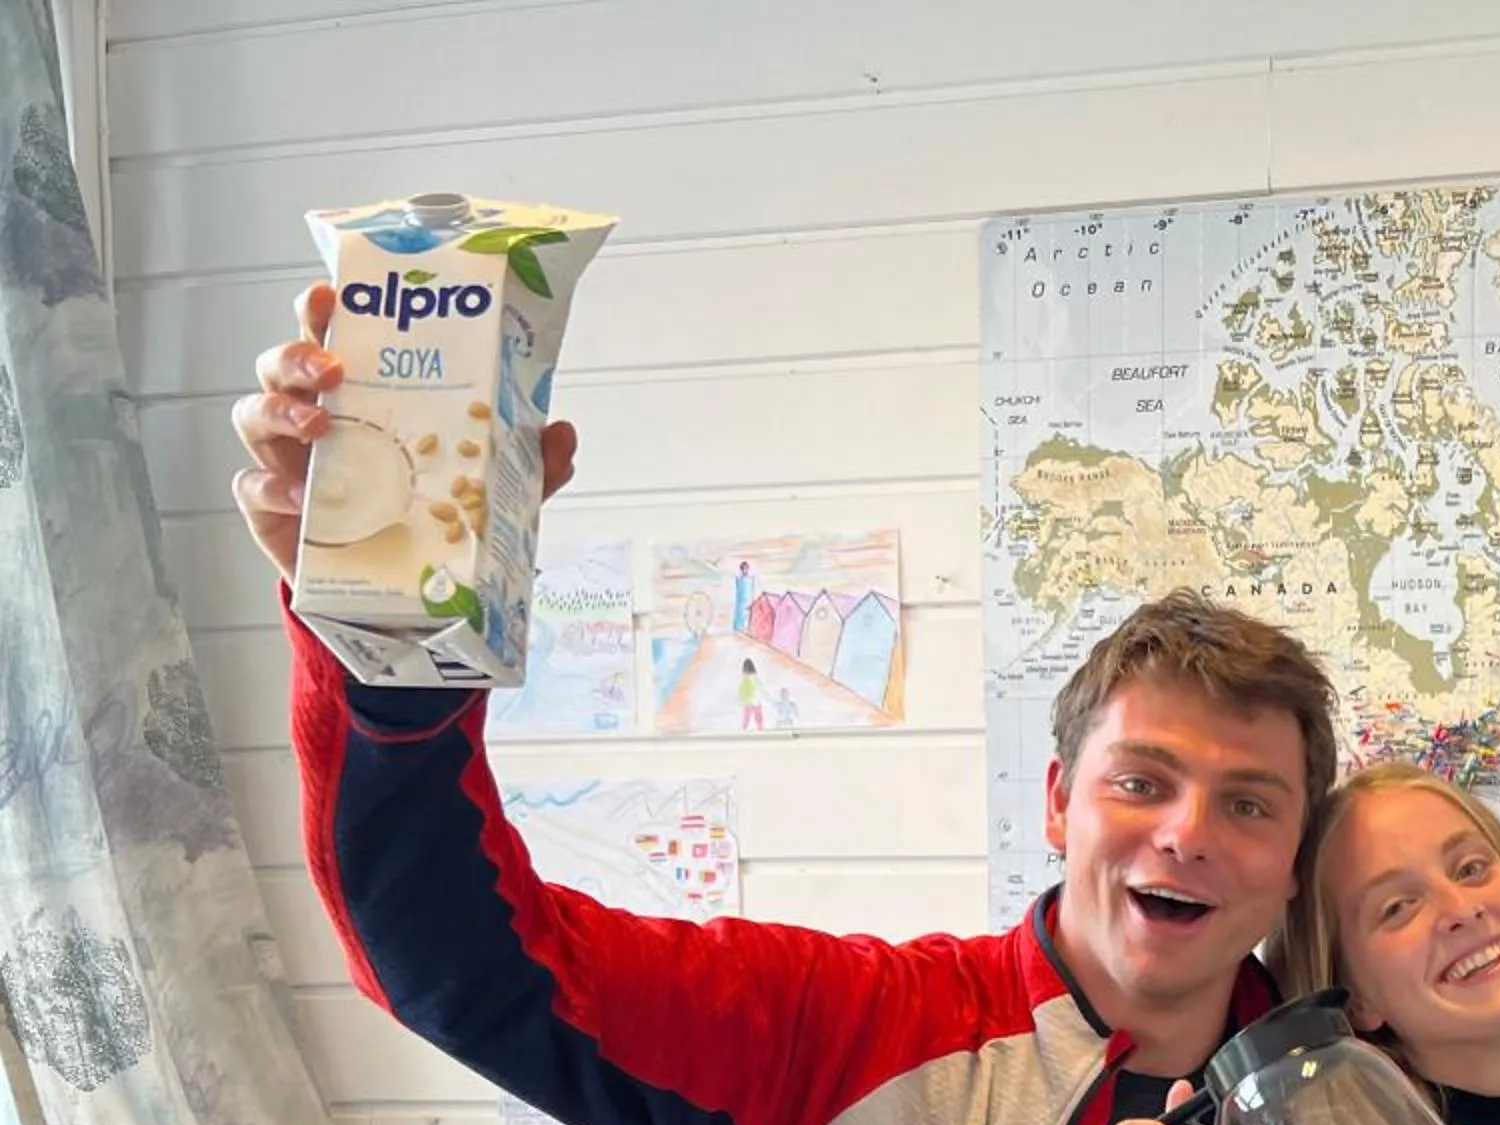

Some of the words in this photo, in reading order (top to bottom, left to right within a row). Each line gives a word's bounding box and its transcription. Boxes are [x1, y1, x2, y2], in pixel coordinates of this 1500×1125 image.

[1024, 242, 1160, 262] Arctic
[1031, 279, 1153, 298] Ocean
[340, 271, 492, 332] alpro
[379, 348, 442, 379] SOYA
[1111, 365, 1188, 381] BEAUFORT
[1135, 399, 1164, 412] SEA
[1008, 415, 1028, 425] SEA
[1201, 581, 1338, 597] CANADA
[1391, 579, 1441, 590] HUDSON
[1405, 603, 1428, 613] BAY
